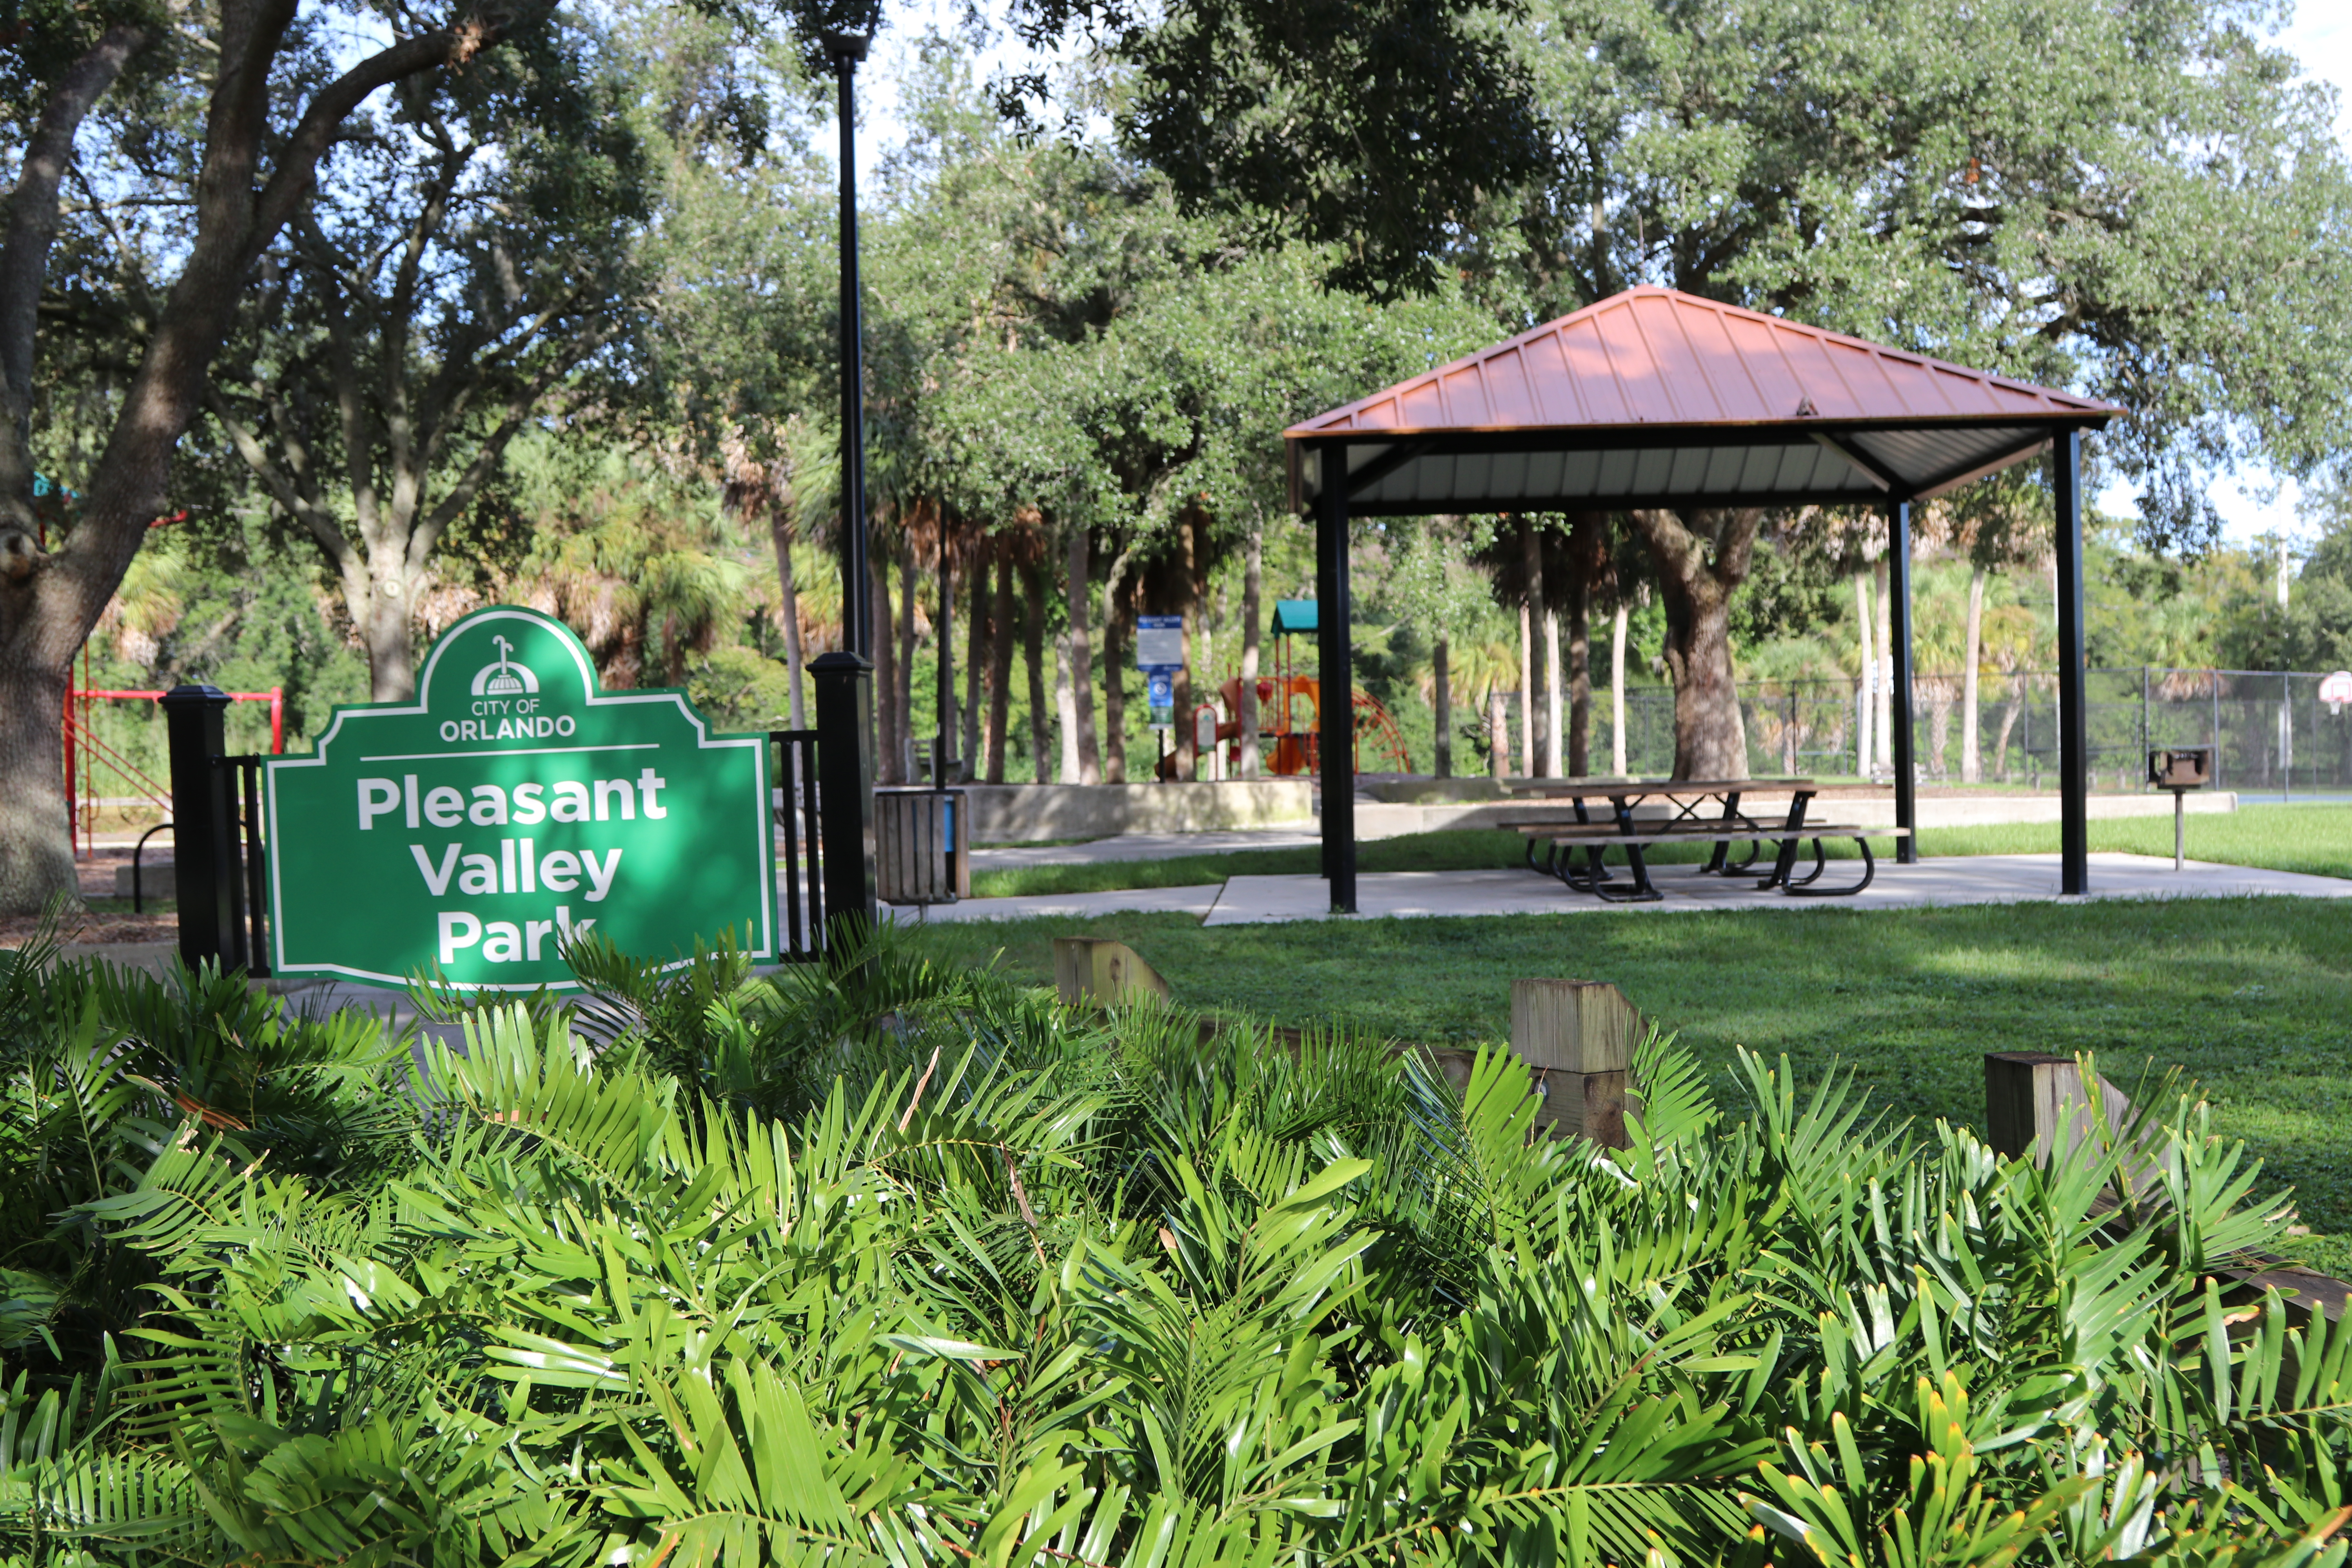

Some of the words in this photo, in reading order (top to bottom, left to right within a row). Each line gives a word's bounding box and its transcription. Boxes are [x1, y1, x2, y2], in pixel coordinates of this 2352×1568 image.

[439, 715, 576, 742] ORLANDO
[471, 700, 510, 716] CITY
[515, 698, 540, 714] OF
[357, 768, 668, 830] Pleasant
[409, 837, 623, 902] Valley
